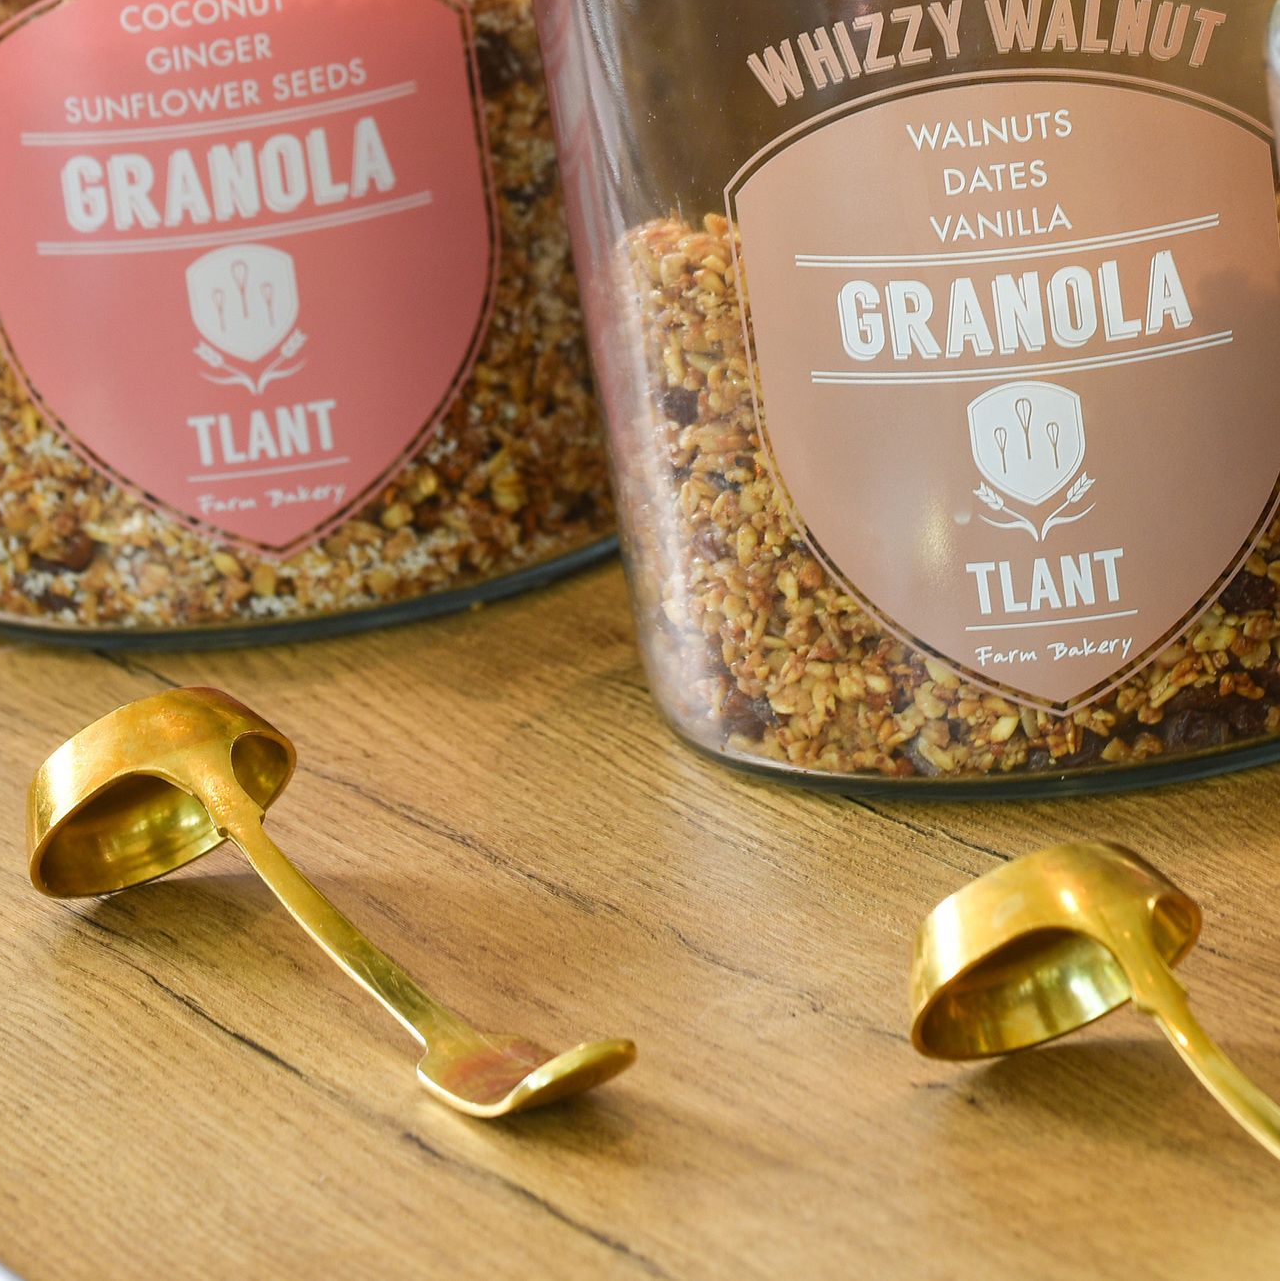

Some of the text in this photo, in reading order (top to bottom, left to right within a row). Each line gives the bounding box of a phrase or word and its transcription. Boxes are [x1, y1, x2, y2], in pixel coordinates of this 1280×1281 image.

[145, 33, 273, 75] GINGER
[63, 57, 368, 125] SUNFLOWER SEEDS
[905, 108, 1074, 151] WALNUTS
[60, 116, 397, 235] GRANOLA
[942, 159, 1049, 197] DATES
[928, 203, 1073, 244] VANILLA
[835, 249, 1194, 361] GRANOLA
[187, 399, 337, 467] TLANT
[197, 481, 348, 513] Farm Bakery
[964, 546, 1125, 616] TLANT
[973, 634, 1134, 668] Farm Bakery
